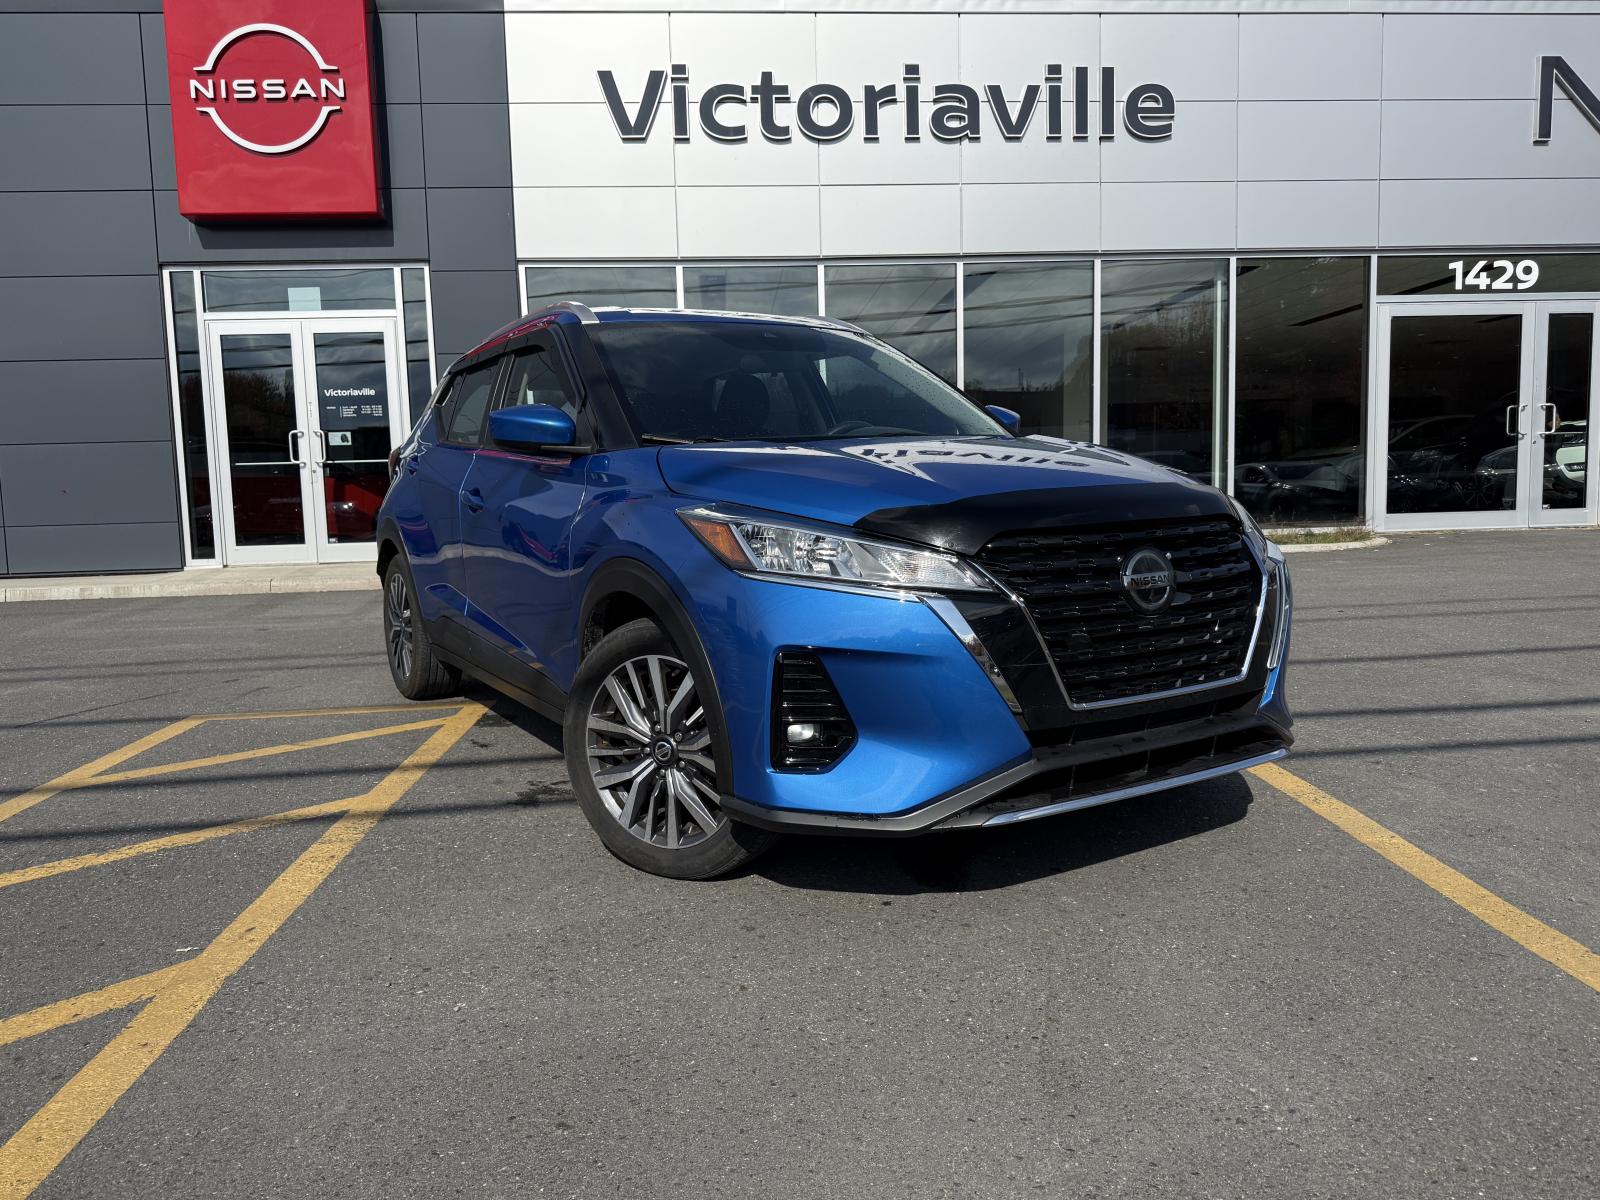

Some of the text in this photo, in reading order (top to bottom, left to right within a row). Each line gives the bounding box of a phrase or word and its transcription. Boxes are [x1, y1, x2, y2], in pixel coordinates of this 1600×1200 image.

[189, 78, 346, 101] NISSAN
[596, 64, 1176, 142] Victoriaville
[1448, 259, 1540, 290] 1429
[324, 388, 376, 396] Victoriaville
[1130, 573, 1170, 587] NISSAN
